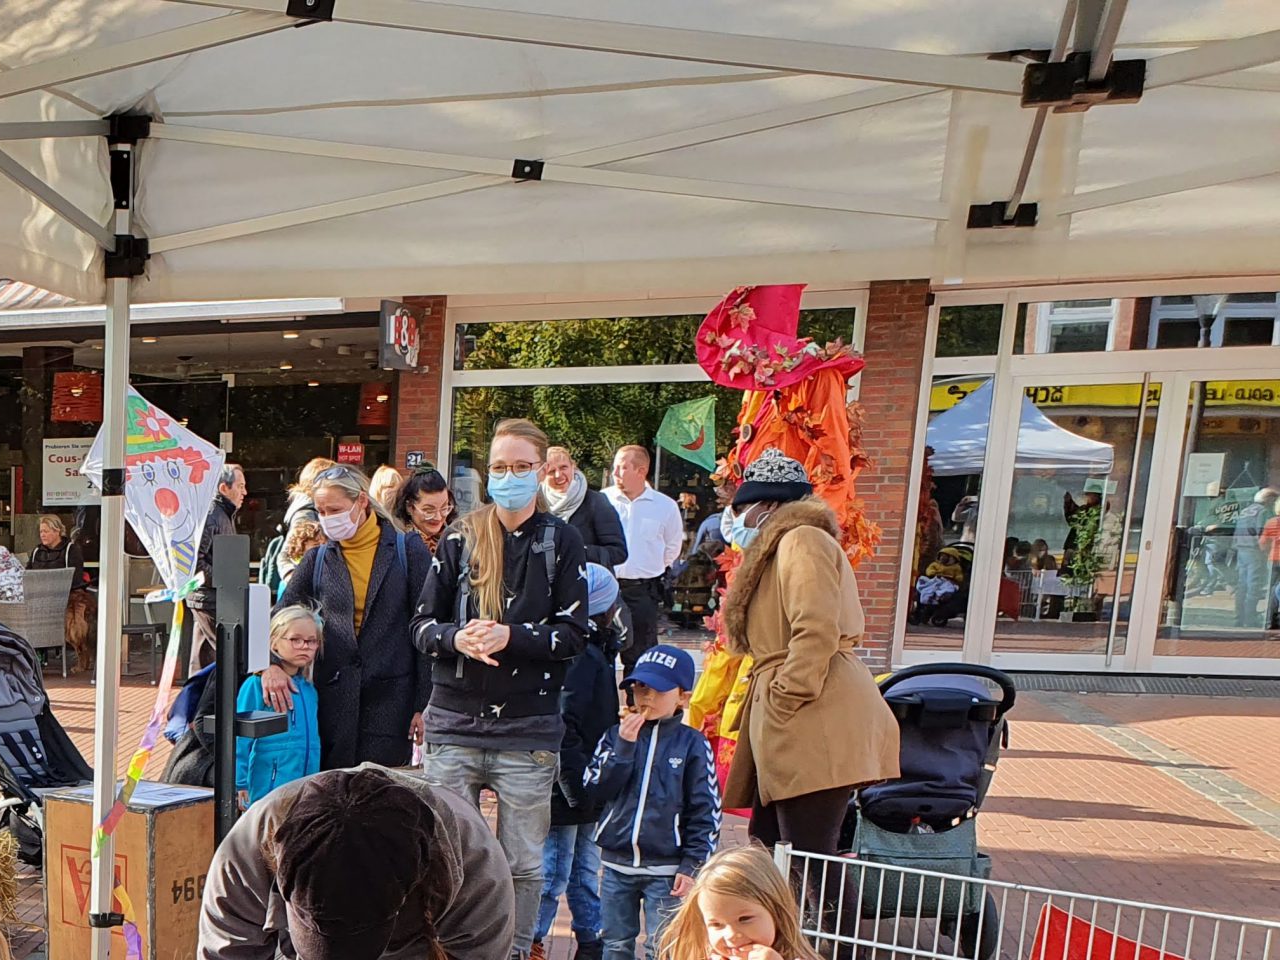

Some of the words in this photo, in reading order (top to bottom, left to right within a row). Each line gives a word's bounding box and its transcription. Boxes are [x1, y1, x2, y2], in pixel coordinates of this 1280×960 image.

[339, 445, 362, 453] W-LAN
[407, 454, 422, 465] 21
[1222, 505, 1260, 523] FASS
